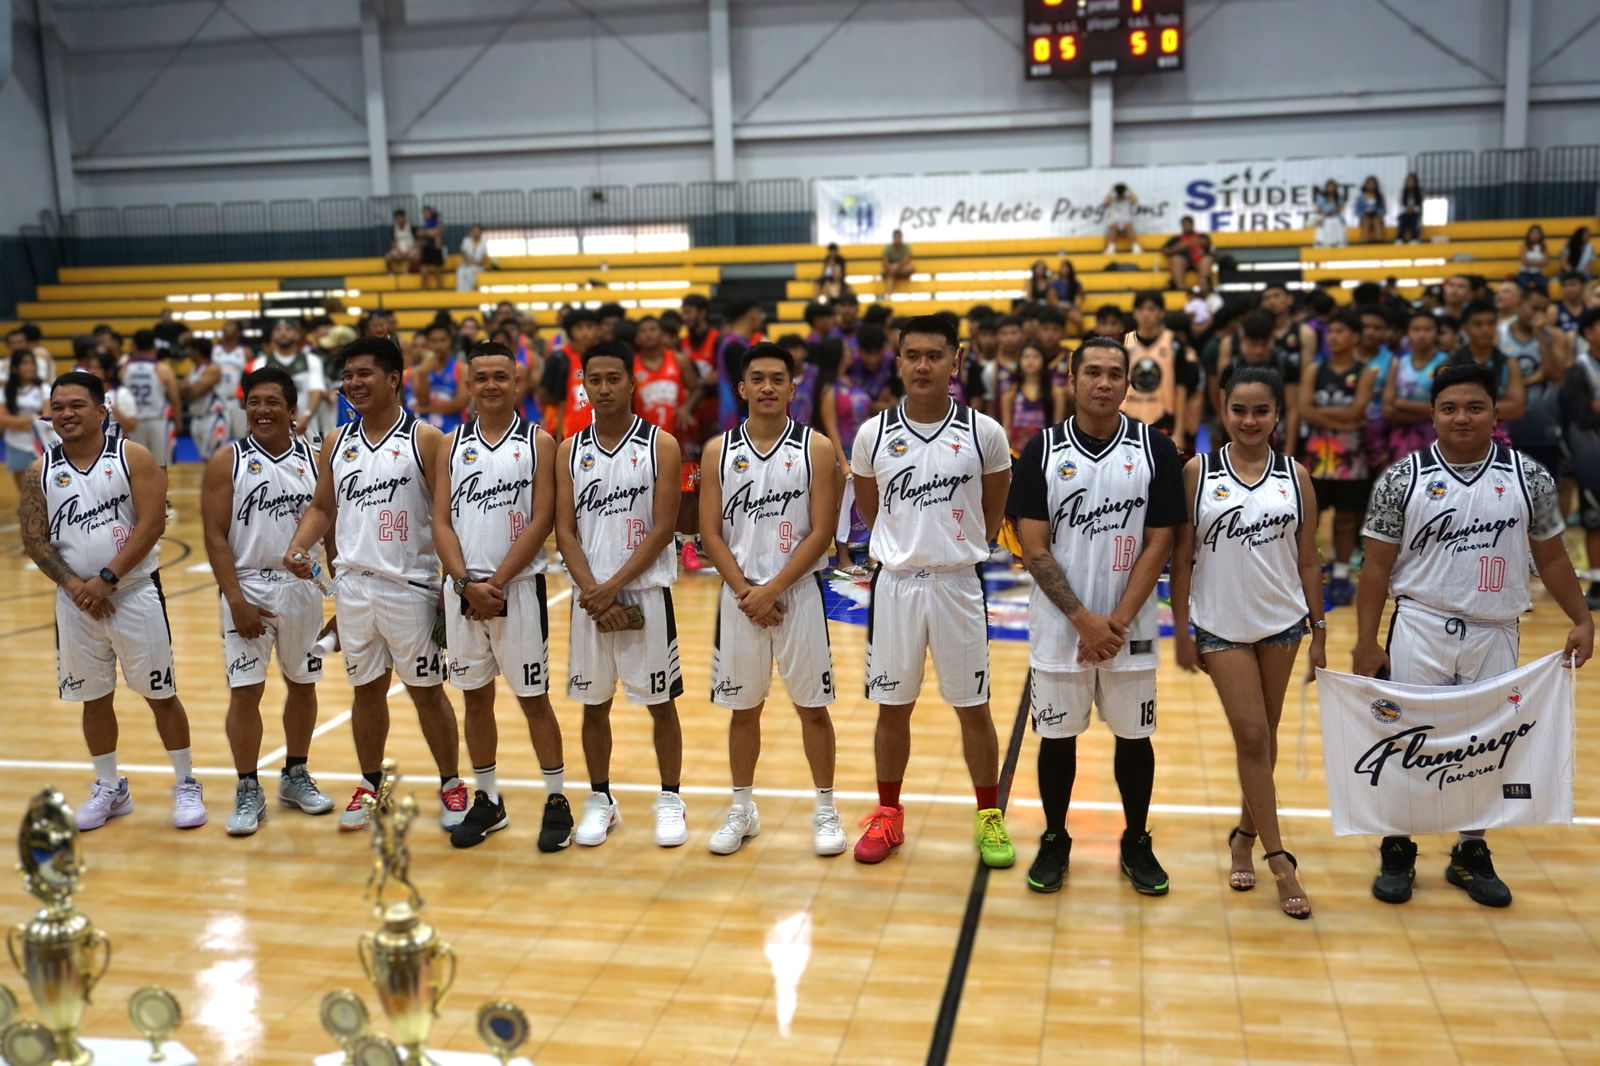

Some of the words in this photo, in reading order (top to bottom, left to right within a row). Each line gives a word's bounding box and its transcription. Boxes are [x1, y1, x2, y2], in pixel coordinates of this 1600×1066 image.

[1033, 38, 1050, 62] 0
[1161, 28, 1178, 53] 0
[948, 200, 1042, 224] Athletic
[1051, 197, 1169, 225] Progms
[451, 471, 532, 517] Flamingo
[884, 465, 973, 514] Flamingo
[237, 481, 312, 526] Flamingo
[1051, 488, 1146, 544] Flamingo
[49, 494, 130, 541] Flamingo
[379, 510, 408, 541] 24
[779, 521, 792, 553] 9
[1409, 508, 1519, 556] Flamingo
[1445, 539, 1491, 557] Tavern
[1477, 556, 1506, 592] 10
[150, 667, 172, 690] 24
[416, 653, 440, 677] 24
[523, 662, 541, 686] 12
[650, 671, 666, 694] 13
[822, 671, 831, 694] 9
[974, 671, 985, 694] 7
[1140, 700, 1154, 726] 18
[1354, 720, 1536, 786] Flamingo
[1426, 763, 1496, 790] Tavern
